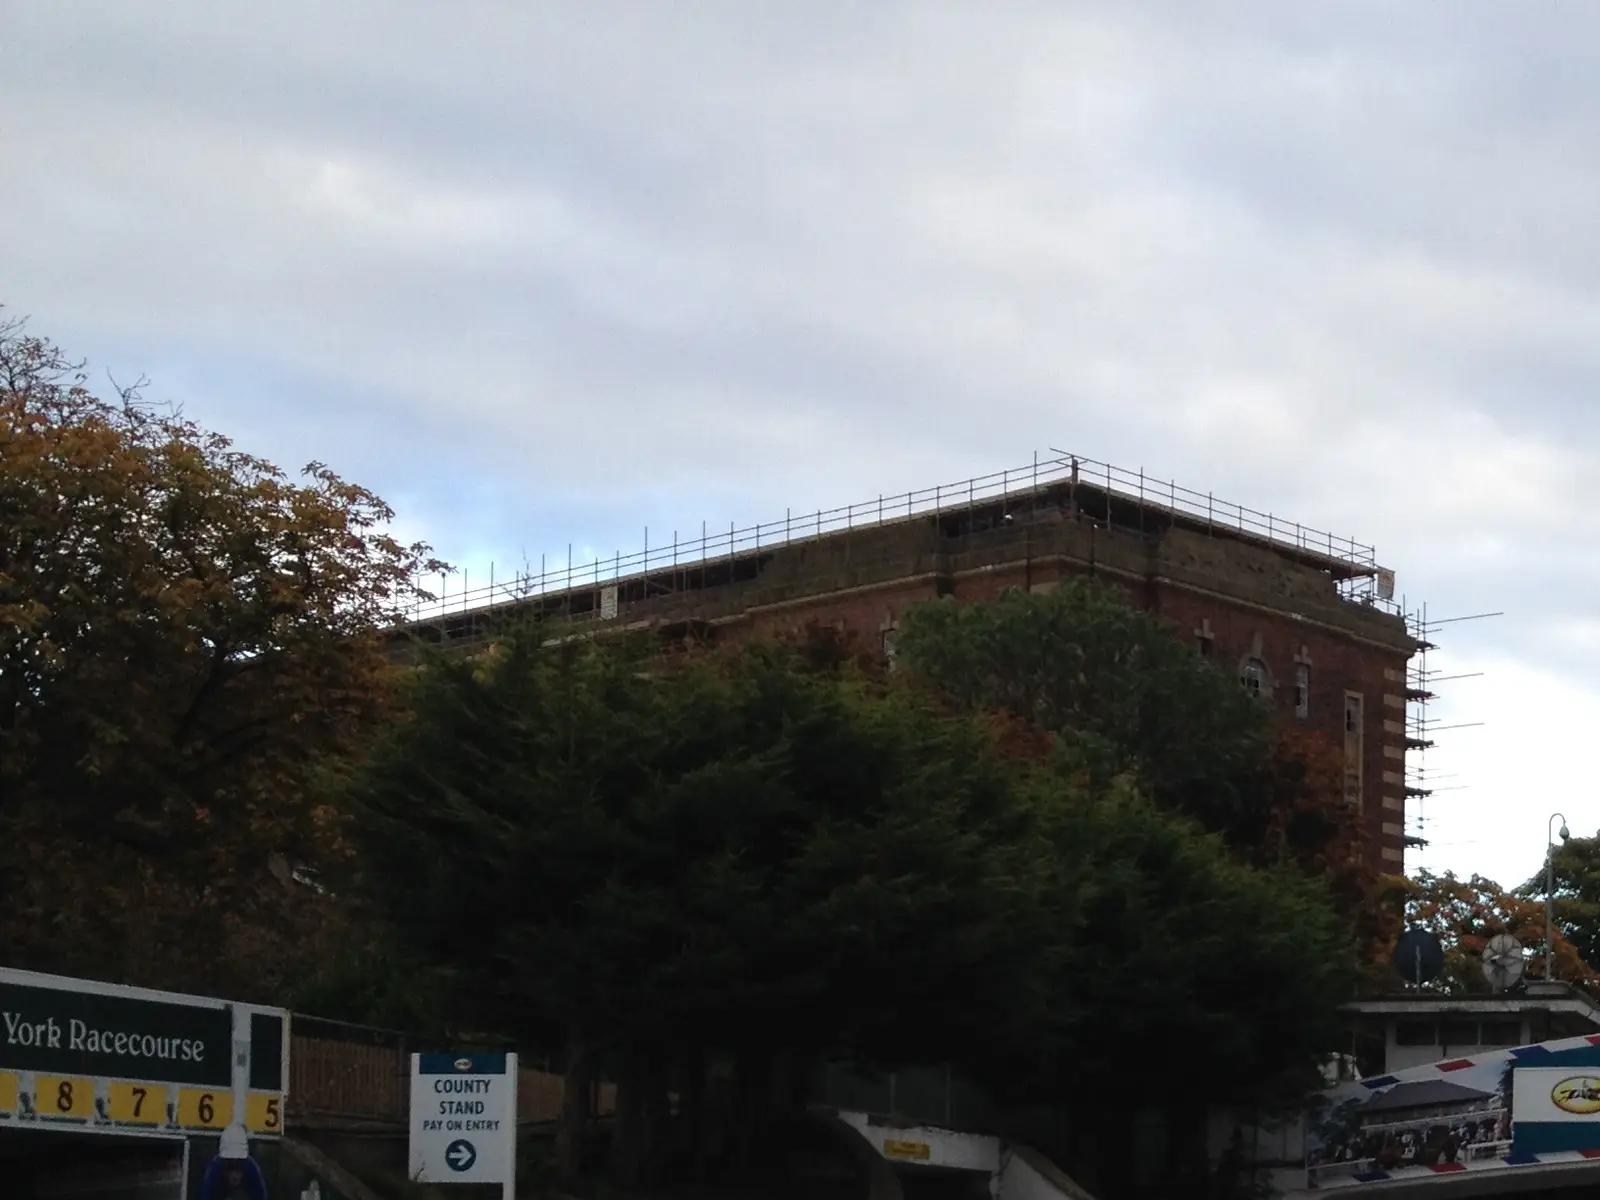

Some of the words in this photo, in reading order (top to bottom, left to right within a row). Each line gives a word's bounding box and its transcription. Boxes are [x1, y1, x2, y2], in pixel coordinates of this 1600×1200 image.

[2, 1011, 62, 1049] York
[68, 1018, 205, 1063] Racecourse
[434, 1079, 491, 1094] COUNTY
[56, 1081, 73, 1112] 8
[132, 1087, 148, 1117] 7
[198, 1094, 215, 1123] 6
[264, 1098, 280, 1128] 5
[439, 1101, 485, 1115] STAND
[423, 1120, 443, 1131] PAY
[446, 1120, 462, 1131] ON
[466, 1120, 500, 1131] ENTRY
